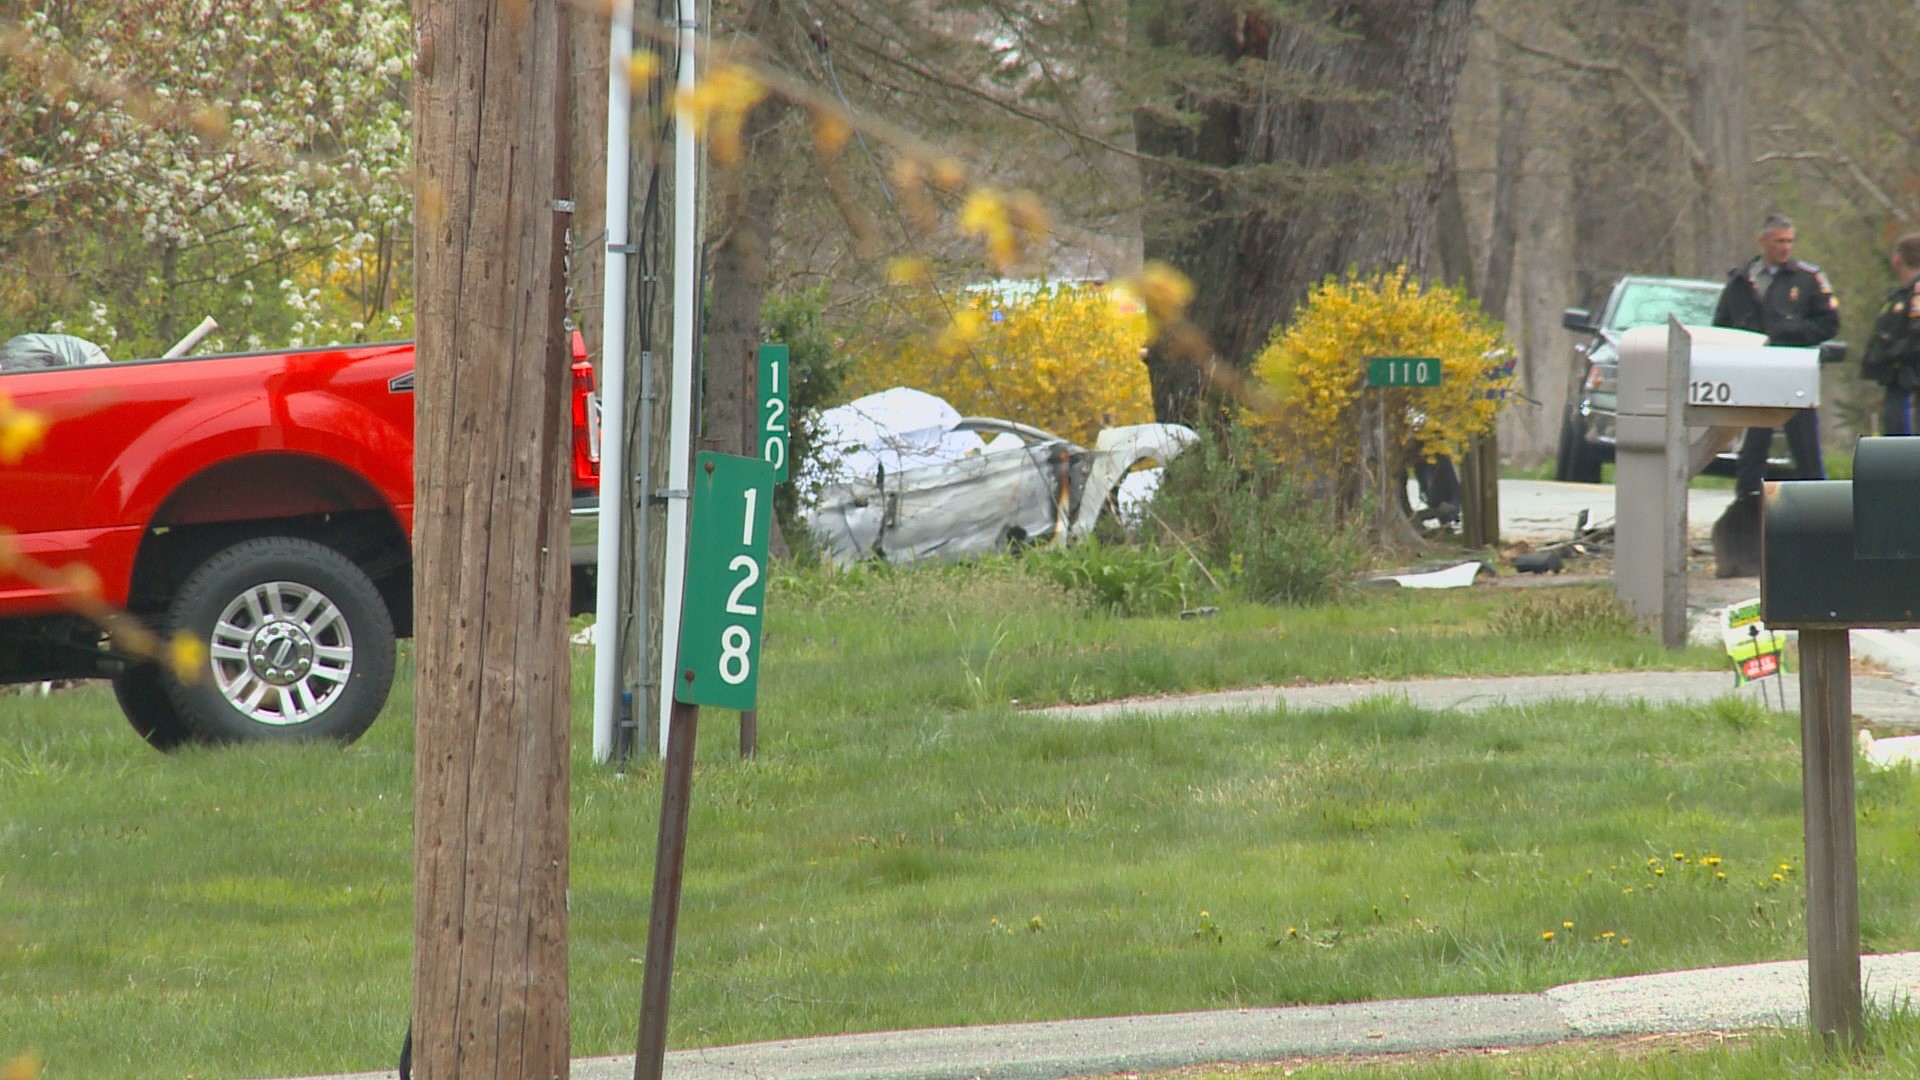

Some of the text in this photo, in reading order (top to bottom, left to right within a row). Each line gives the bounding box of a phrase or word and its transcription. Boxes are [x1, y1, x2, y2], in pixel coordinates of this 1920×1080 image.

[1388, 362, 1428, 384] 110
[1690, 381, 1731, 402] 120
[765, 361, 785, 471] 120
[718, 487, 760, 685] 128
